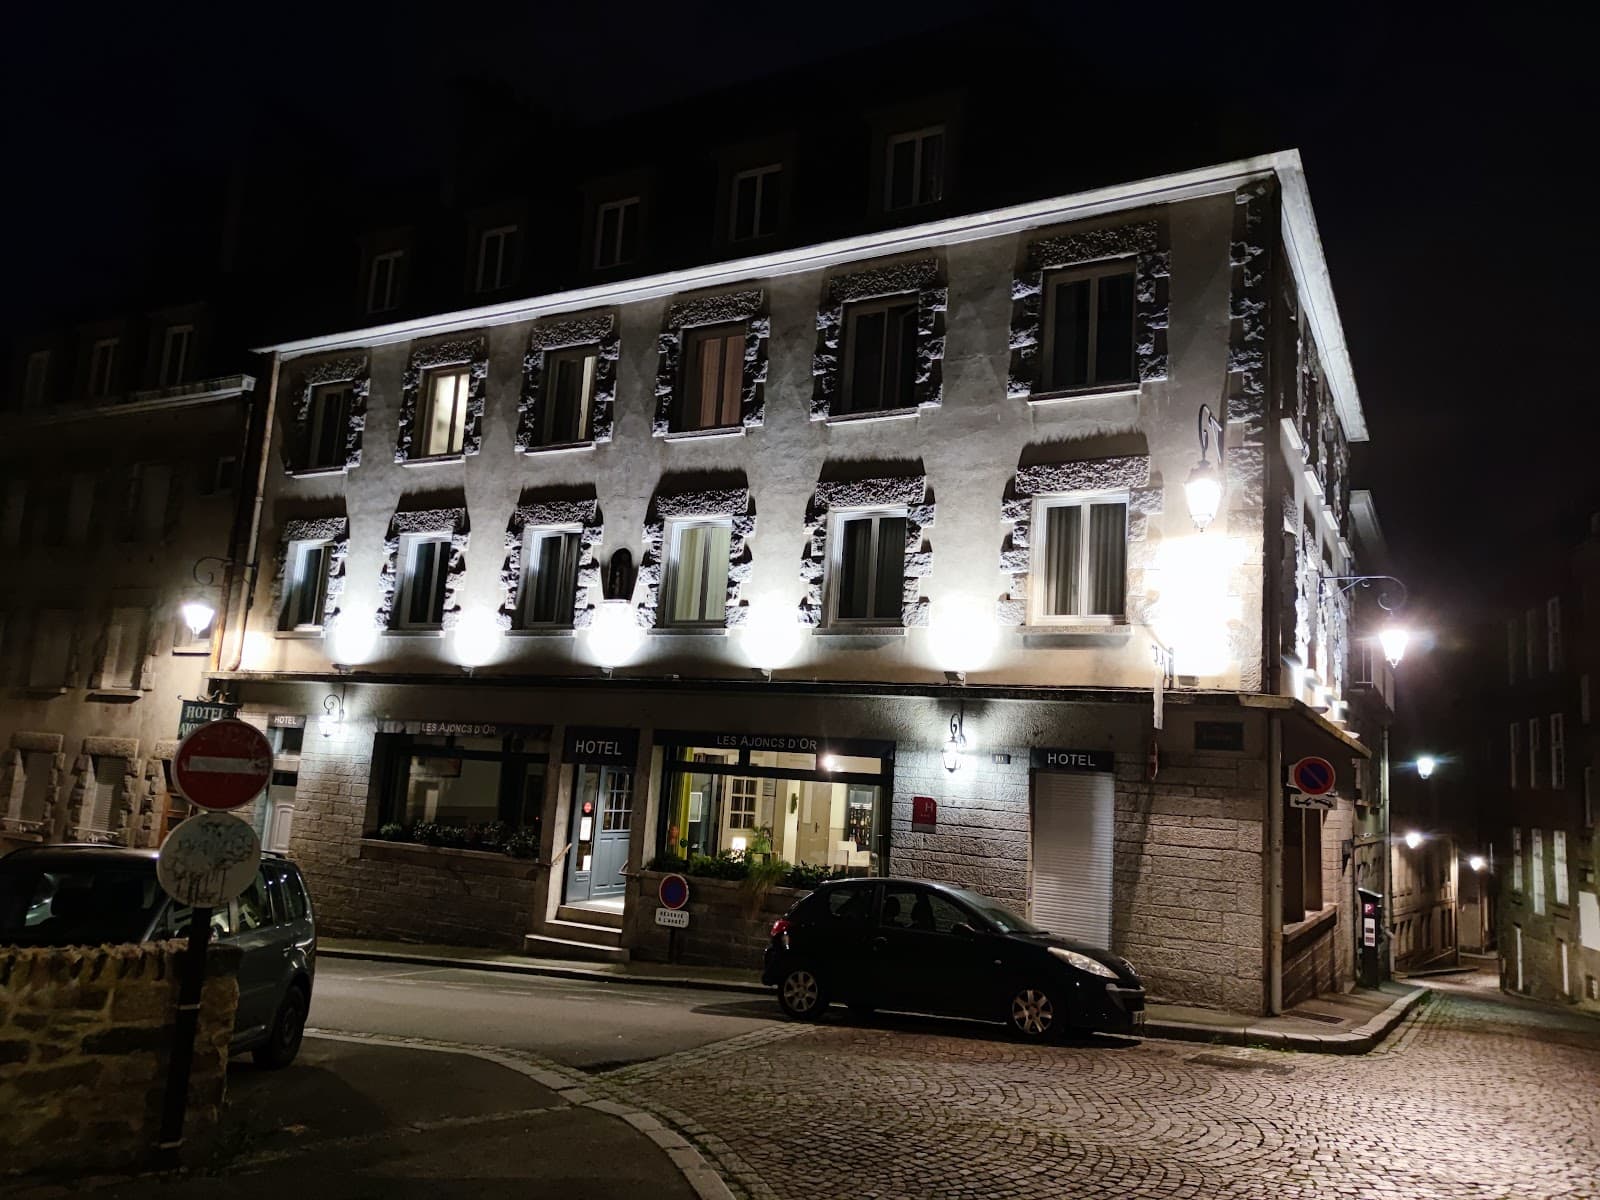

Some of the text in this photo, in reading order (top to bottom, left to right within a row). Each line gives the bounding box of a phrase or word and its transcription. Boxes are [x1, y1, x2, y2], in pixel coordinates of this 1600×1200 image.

[186, 706, 223, 721] HOTEL
[274, 715, 297, 725] HOTEL
[421, 722, 497, 736] LES AJONCS D'OR
[575, 739, 623, 756] HOTEL
[717, 735, 817, 751] LES AJONCS D'OR
[1047, 752, 1096, 768] HOTEL
